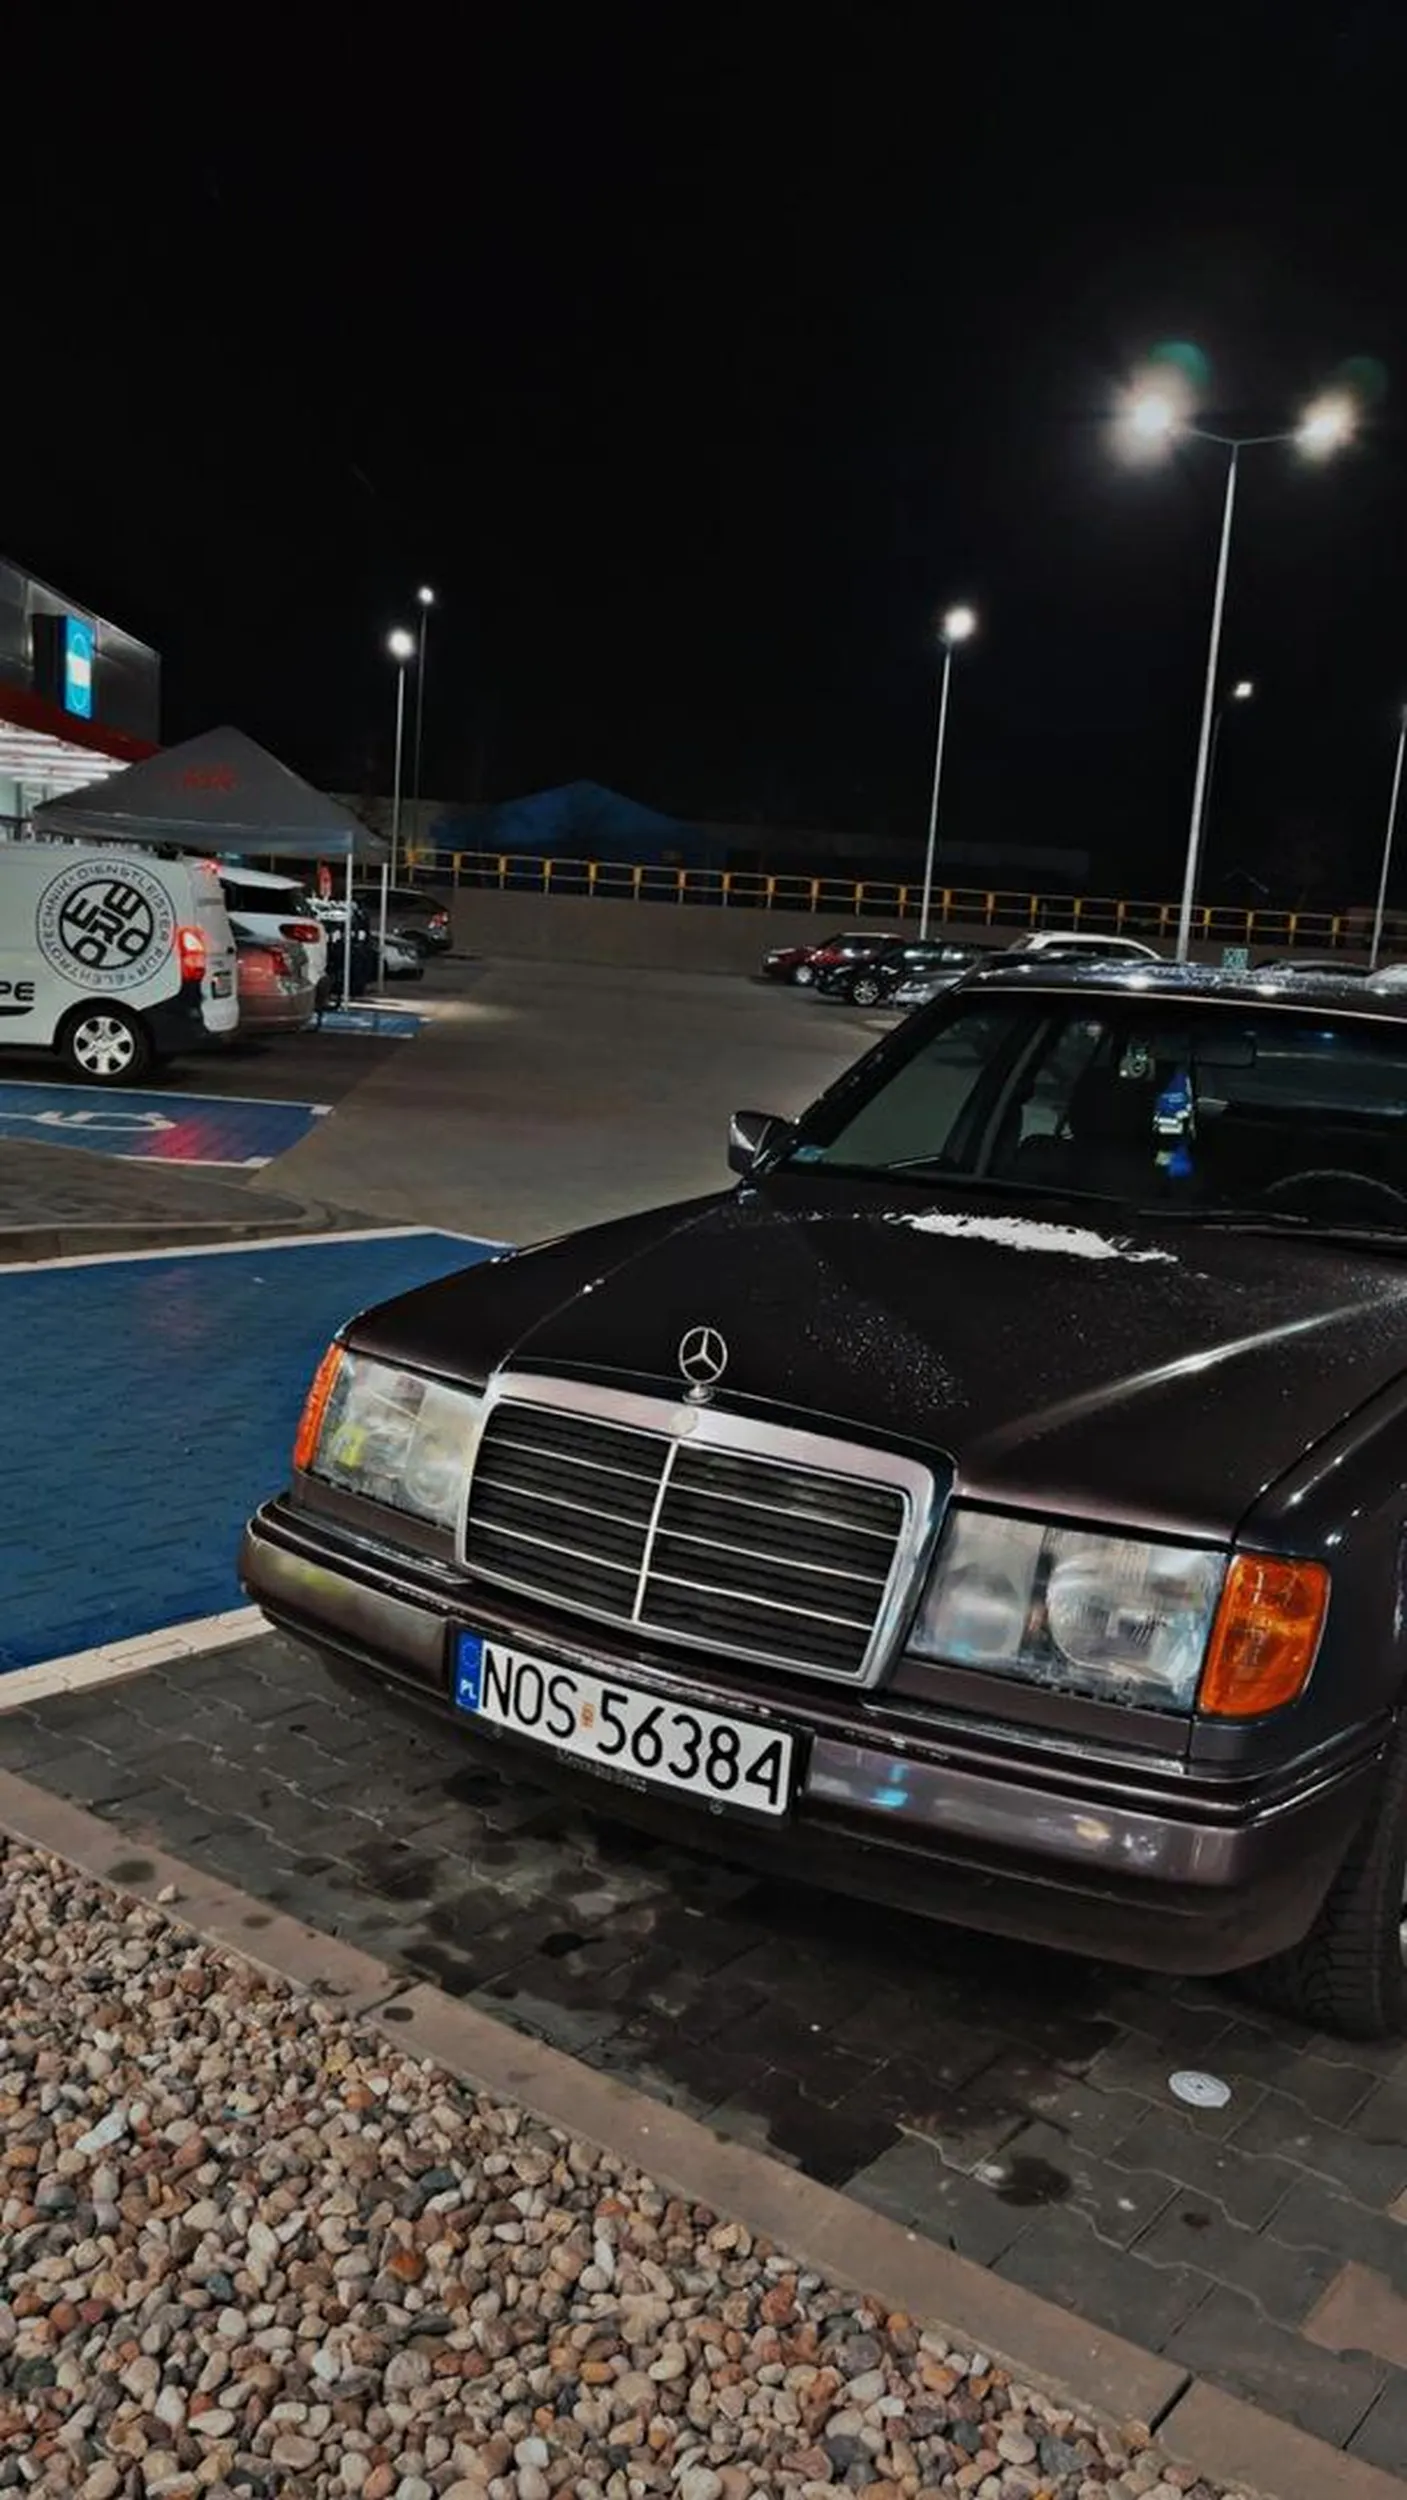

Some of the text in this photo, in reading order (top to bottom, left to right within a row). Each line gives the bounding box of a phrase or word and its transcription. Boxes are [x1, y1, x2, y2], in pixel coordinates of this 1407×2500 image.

[460, 1679, 477, 1699] PL
[482, 1648, 578, 1738] NOS
[597, 1690, 783, 1806] 56384
